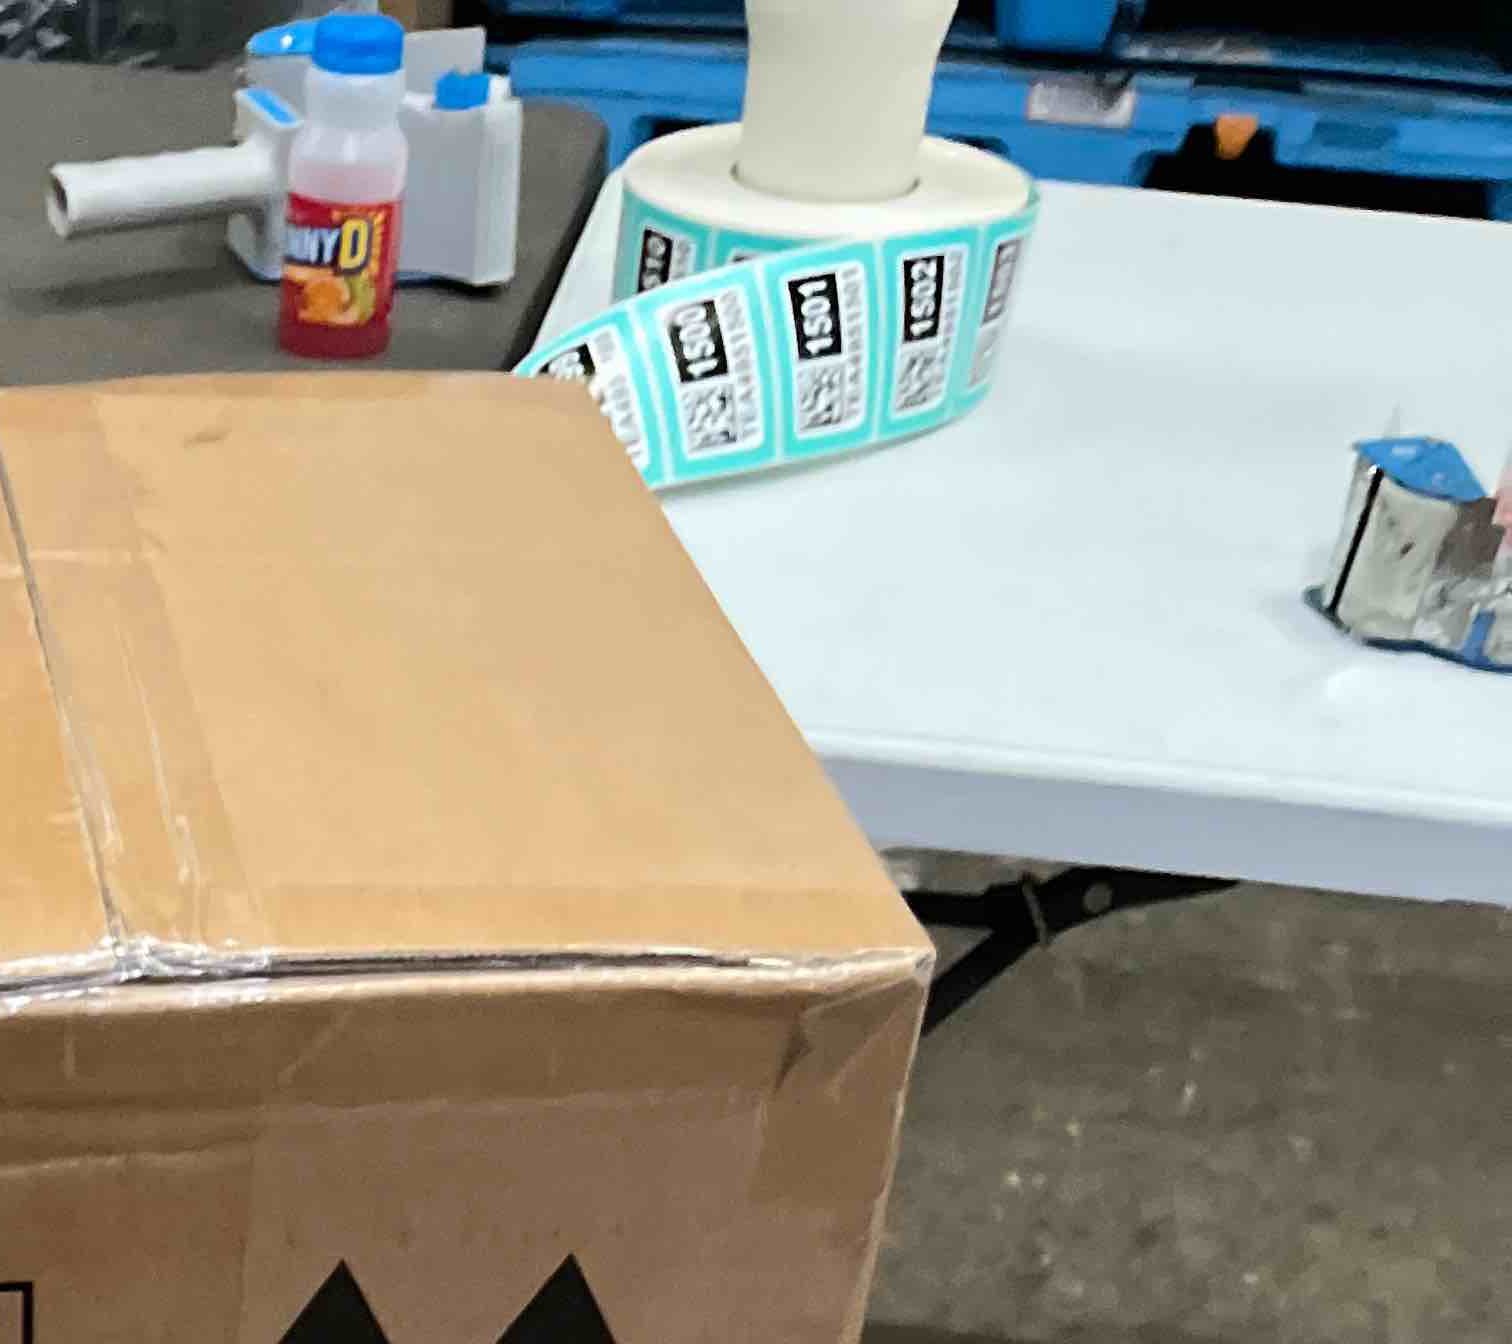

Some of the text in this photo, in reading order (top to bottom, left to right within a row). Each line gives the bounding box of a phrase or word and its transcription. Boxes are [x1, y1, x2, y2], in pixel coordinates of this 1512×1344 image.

[800, 275, 835, 358] 1501
[908, 258, 938, 339] 1502
[674, 303, 720, 379] 1500
